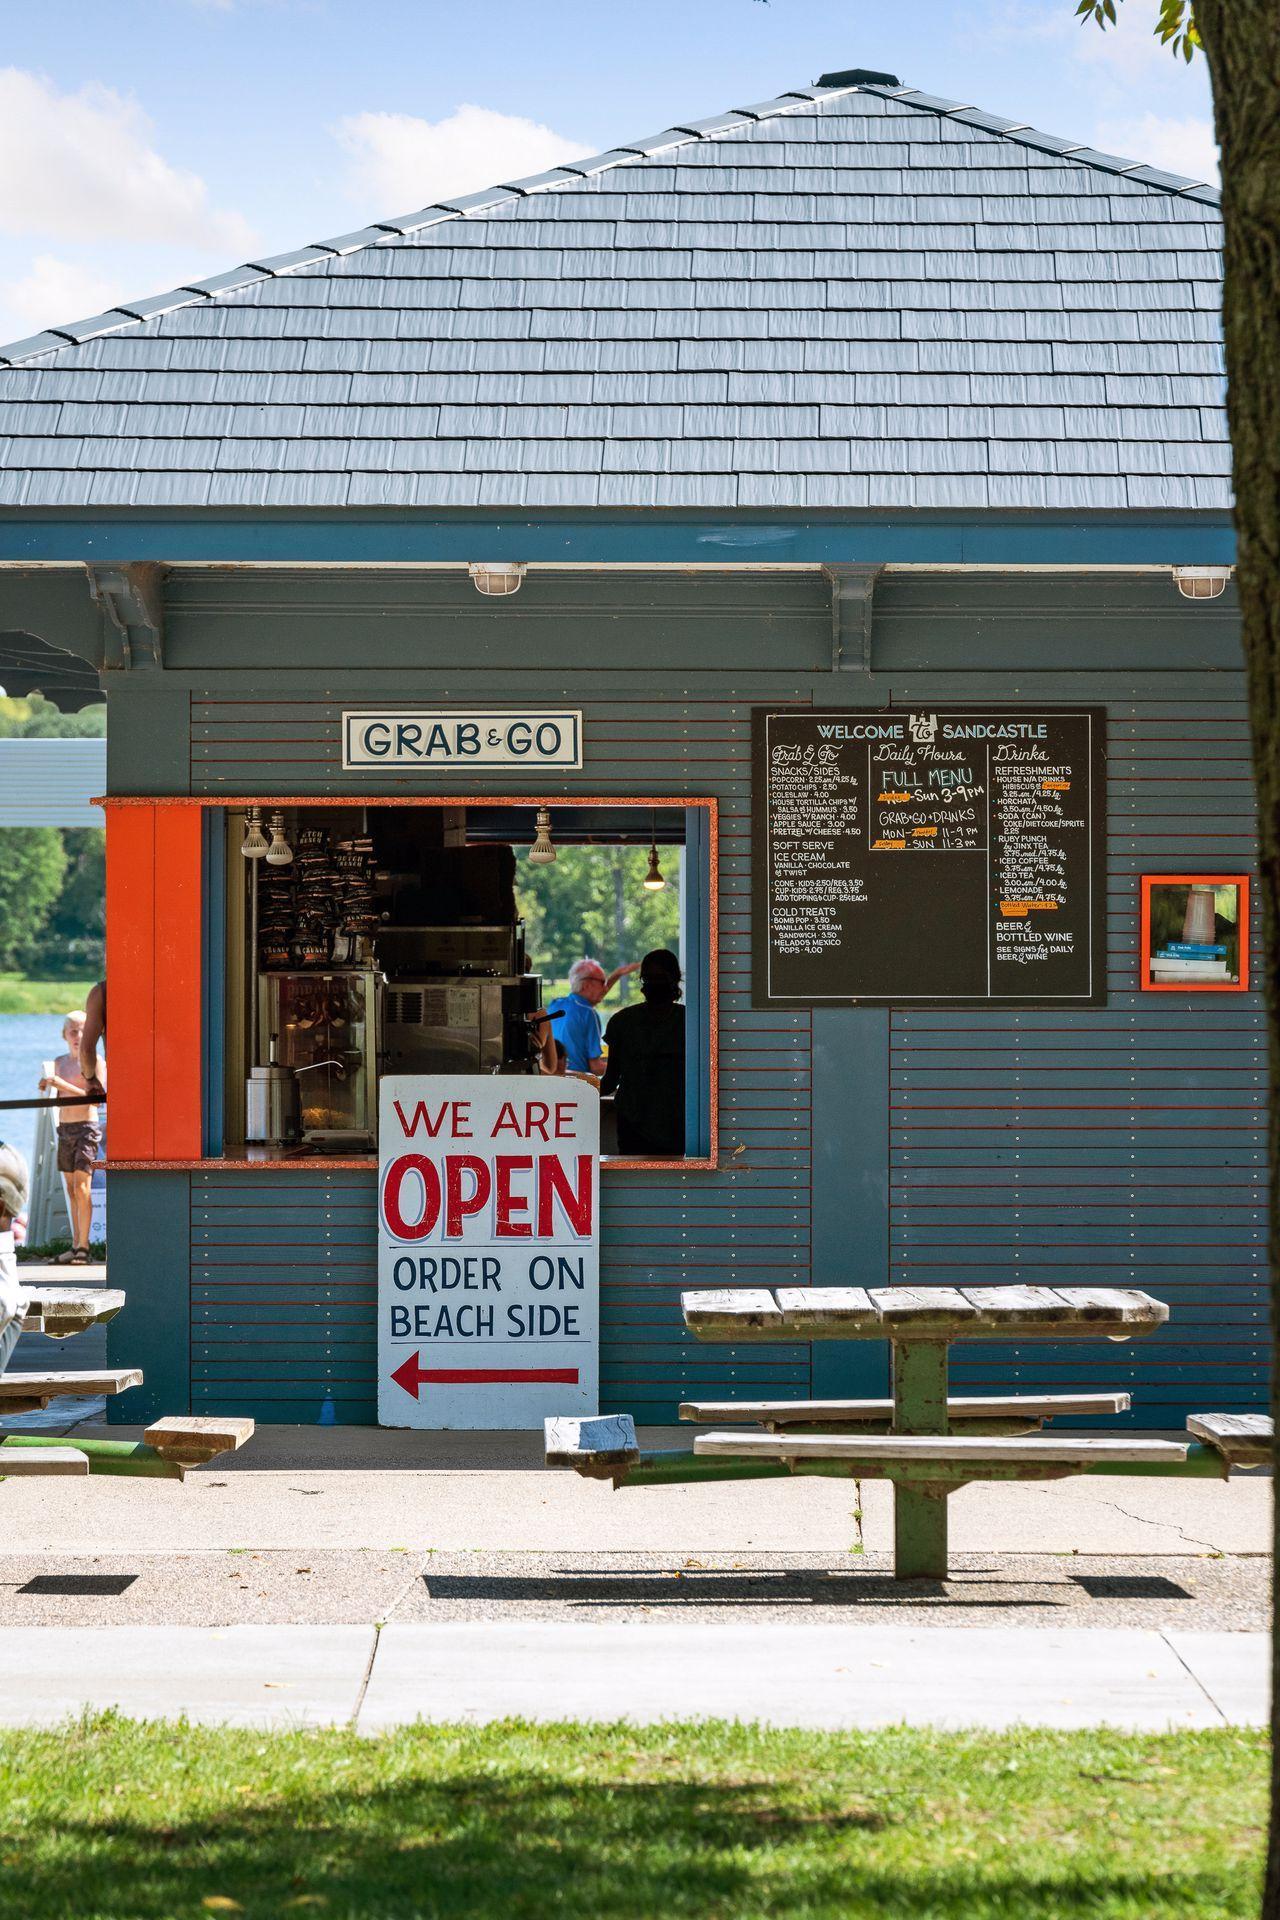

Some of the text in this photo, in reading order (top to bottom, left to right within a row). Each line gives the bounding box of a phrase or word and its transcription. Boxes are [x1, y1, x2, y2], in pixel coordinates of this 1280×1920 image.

[817, 723, 1048, 739] WELCOME to SANDCASTLE
[363, 722, 562, 757] GRAB & GO
[772, 744, 844, 766] Grab & Go
[873, 743, 967, 766] Daily Hours
[992, 744, 1050, 760] Drinks
[770, 767, 840, 776] SNACKS/SIDES
[882, 767, 974, 789] FULL MENU
[995, 766, 1072, 775] REFRESHMENTS
[773, 828, 805, 836] PRETZEL
[966, 827, 978, 836] PM
[774, 853, 826, 861] ICE CREAM
[772, 908, 836, 916] COLD TREATS
[996, 921, 1032, 932] BEER &
[996, 932, 1073, 942] BOTTLED WINE
[1037, 944, 1048, 954] for
[1050, 945, 1074, 953] DAILY
[392, 1100, 578, 1142] WE ARE
[382, 1153, 592, 1241] OPEN
[393, 1255, 585, 1292] ORDER ON
[391, 1303, 580, 1337] BEACH SIDE
